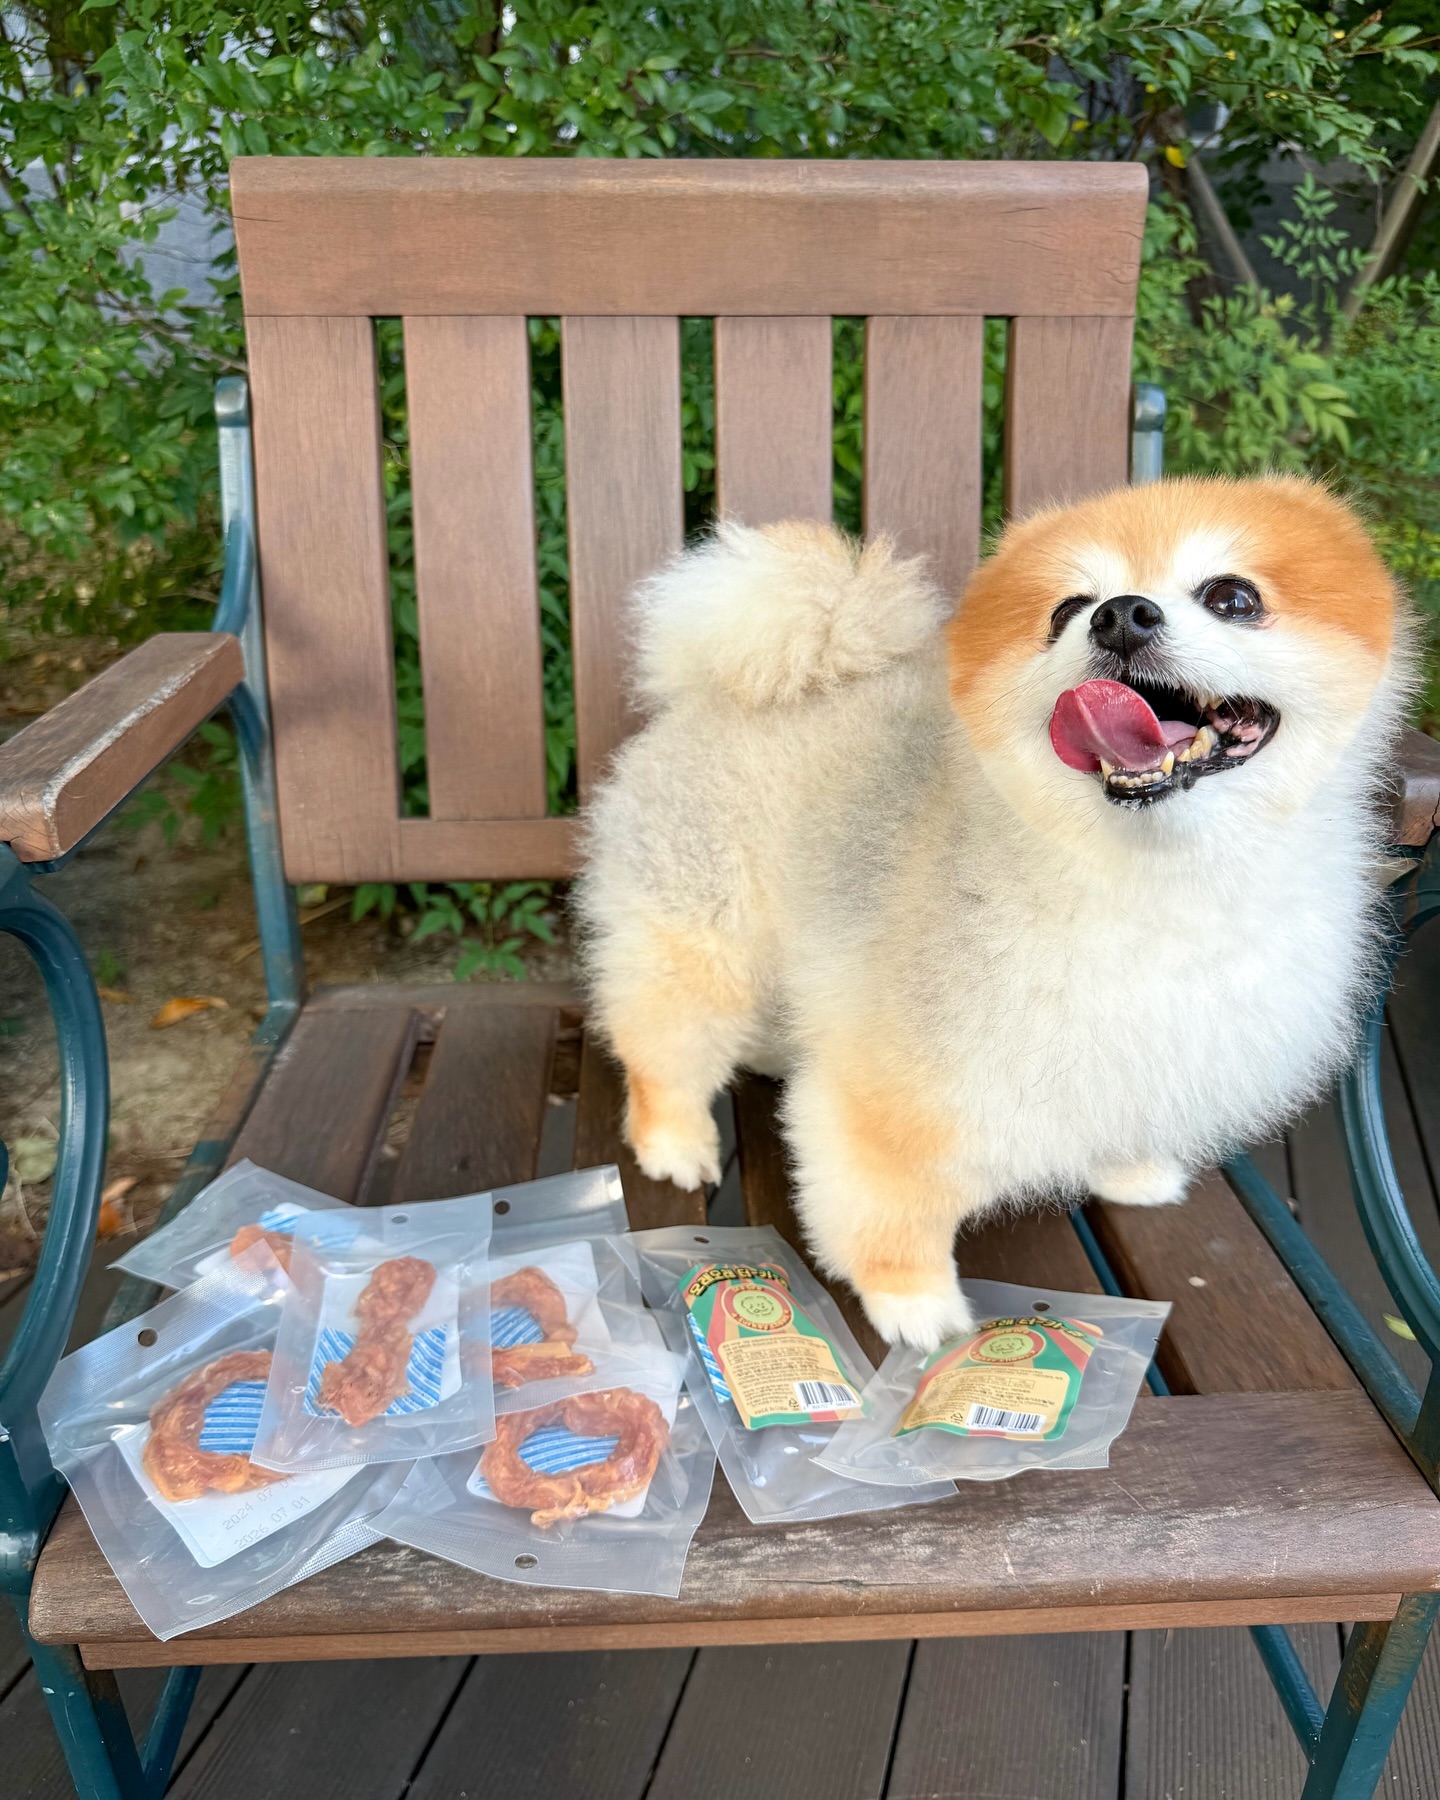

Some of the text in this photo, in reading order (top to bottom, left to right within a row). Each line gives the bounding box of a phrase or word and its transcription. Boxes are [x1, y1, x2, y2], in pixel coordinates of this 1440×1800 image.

[688, 1267, 737, 1297] 오래오래
[222, 1502, 254, 1530] 2024
[256, 1487, 273, 1502] 07
[234, 1496, 311, 1548] 2026 07 01
